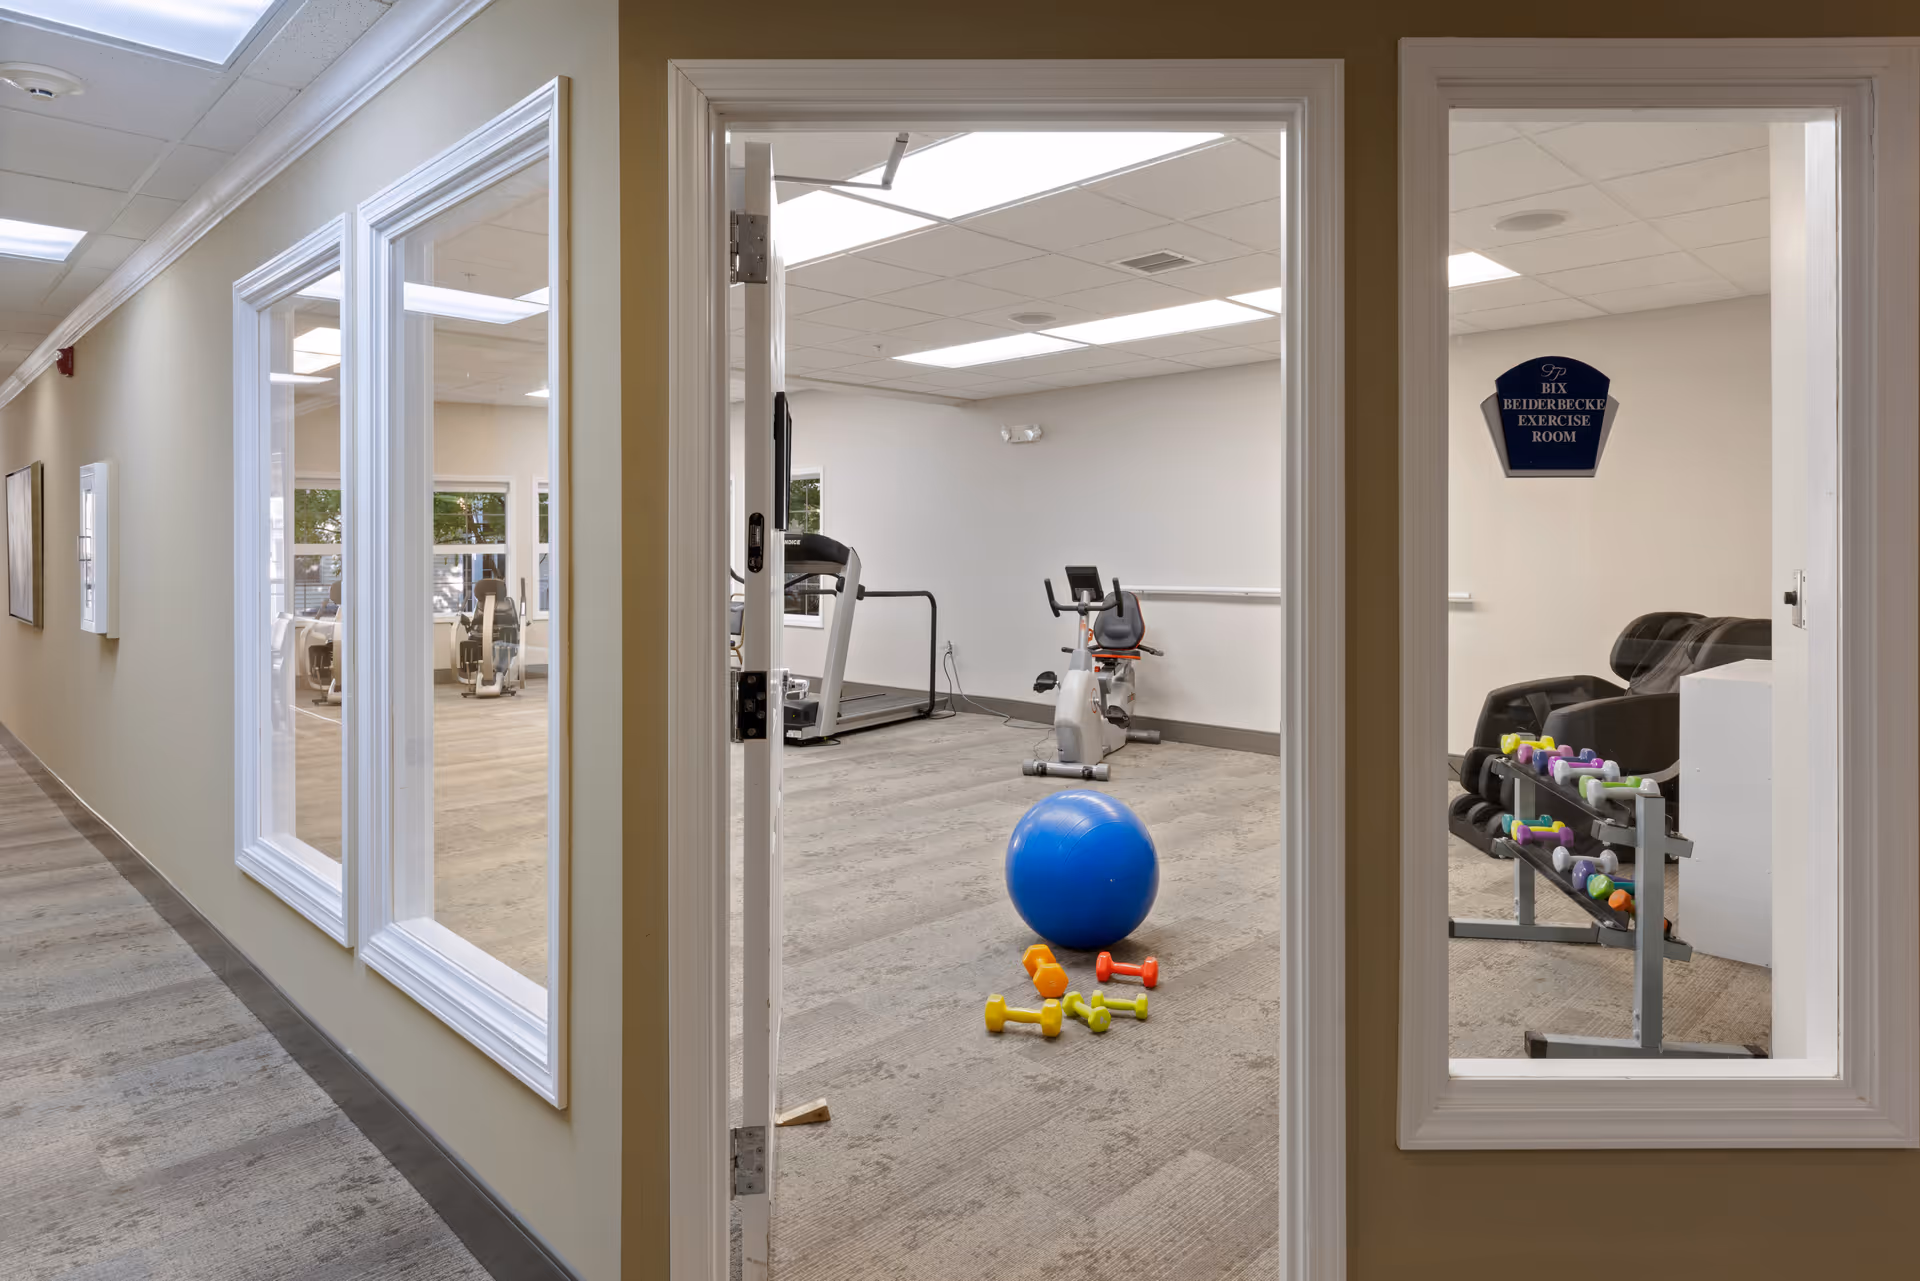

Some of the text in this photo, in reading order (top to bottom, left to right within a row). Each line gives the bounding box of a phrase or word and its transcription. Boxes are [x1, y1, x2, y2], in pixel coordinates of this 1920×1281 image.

[1541, 382, 1567, 394] BIX
[1503, 398, 1606, 411] BEIDERBECKE
[1517, 414, 1591, 427] EXERCISE
[1531, 430, 1577, 443] ROOM
